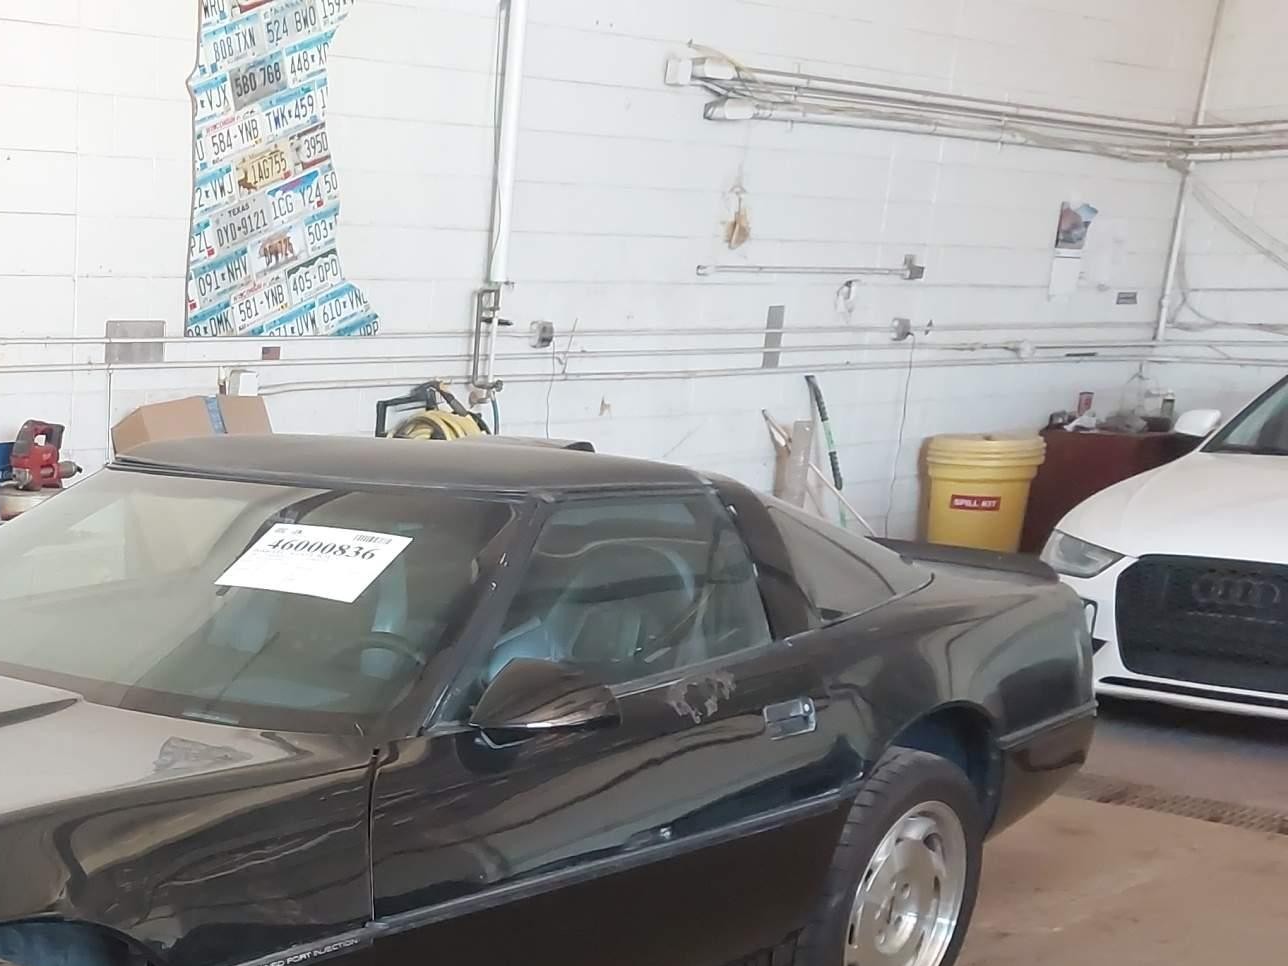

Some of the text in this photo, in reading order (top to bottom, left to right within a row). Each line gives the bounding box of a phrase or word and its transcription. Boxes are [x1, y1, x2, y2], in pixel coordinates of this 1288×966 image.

[227, 203, 250, 217] TEXAS
[268, 537, 380, 560] 46000836
[286, 951, 312, 965] PORT
[313, 938, 359, 957] INJECTION
